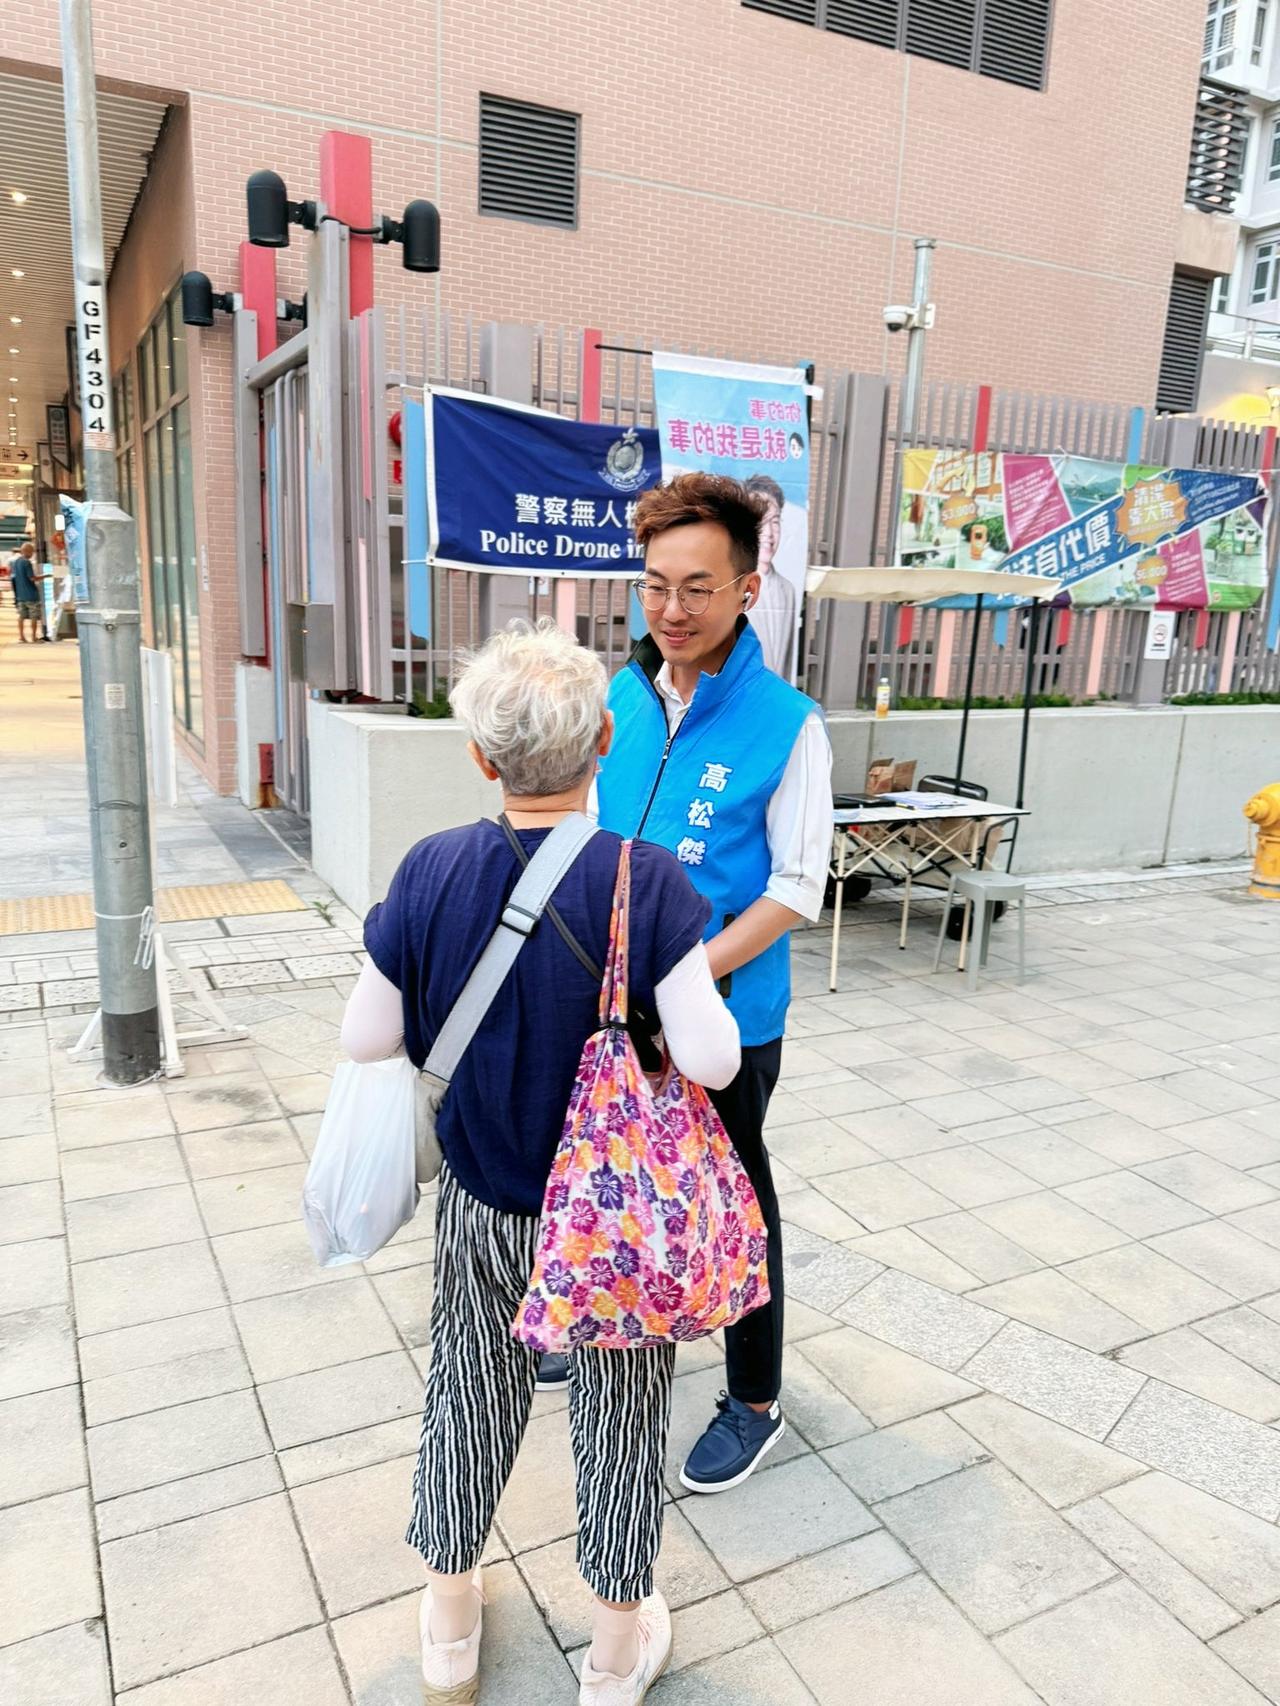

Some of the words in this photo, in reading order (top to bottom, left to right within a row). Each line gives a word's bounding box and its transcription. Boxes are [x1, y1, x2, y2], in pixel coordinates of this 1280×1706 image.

[82, 301, 105, 433] GF4304
[479, 529, 548, 556] Police
[555, 534, 622, 559] Drone
[676, 762, 733, 866] 高松傑
